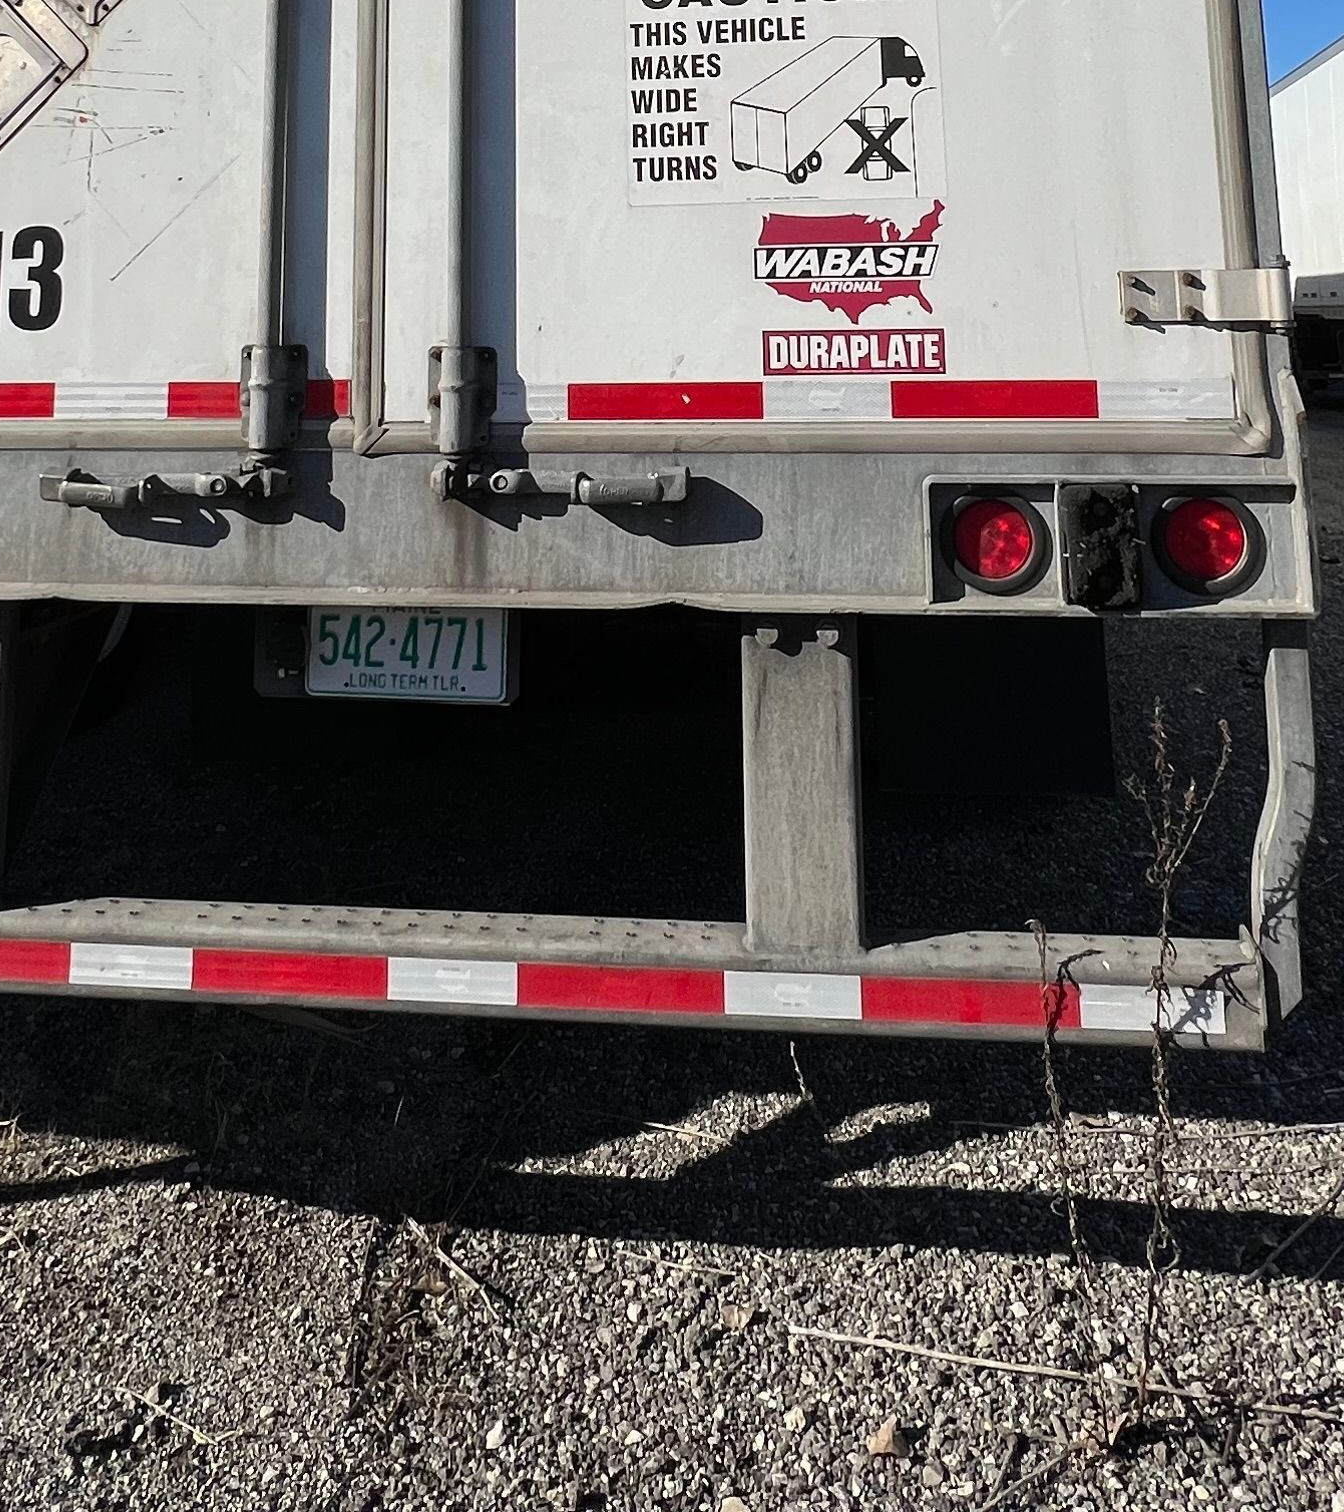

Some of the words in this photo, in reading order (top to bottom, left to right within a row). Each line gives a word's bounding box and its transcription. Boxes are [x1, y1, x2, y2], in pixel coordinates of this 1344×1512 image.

[630, 21, 687, 47] THIS
[697, 16, 805, 44] VEHICLE
[631, 53, 721, 81] MAKES
[631, 88, 697, 114] WIDE
[632, 121, 709, 148] RIGHT
[633, 155, 717, 182] TURNS
[756, 246, 937, 278] WABASH
[809, 280, 883, 294] NATIONAL
[768, 333, 941, 370] DURAPLATE
[349, 673, 386, 688] LONG
[391, 674, 428, 689] TERM
